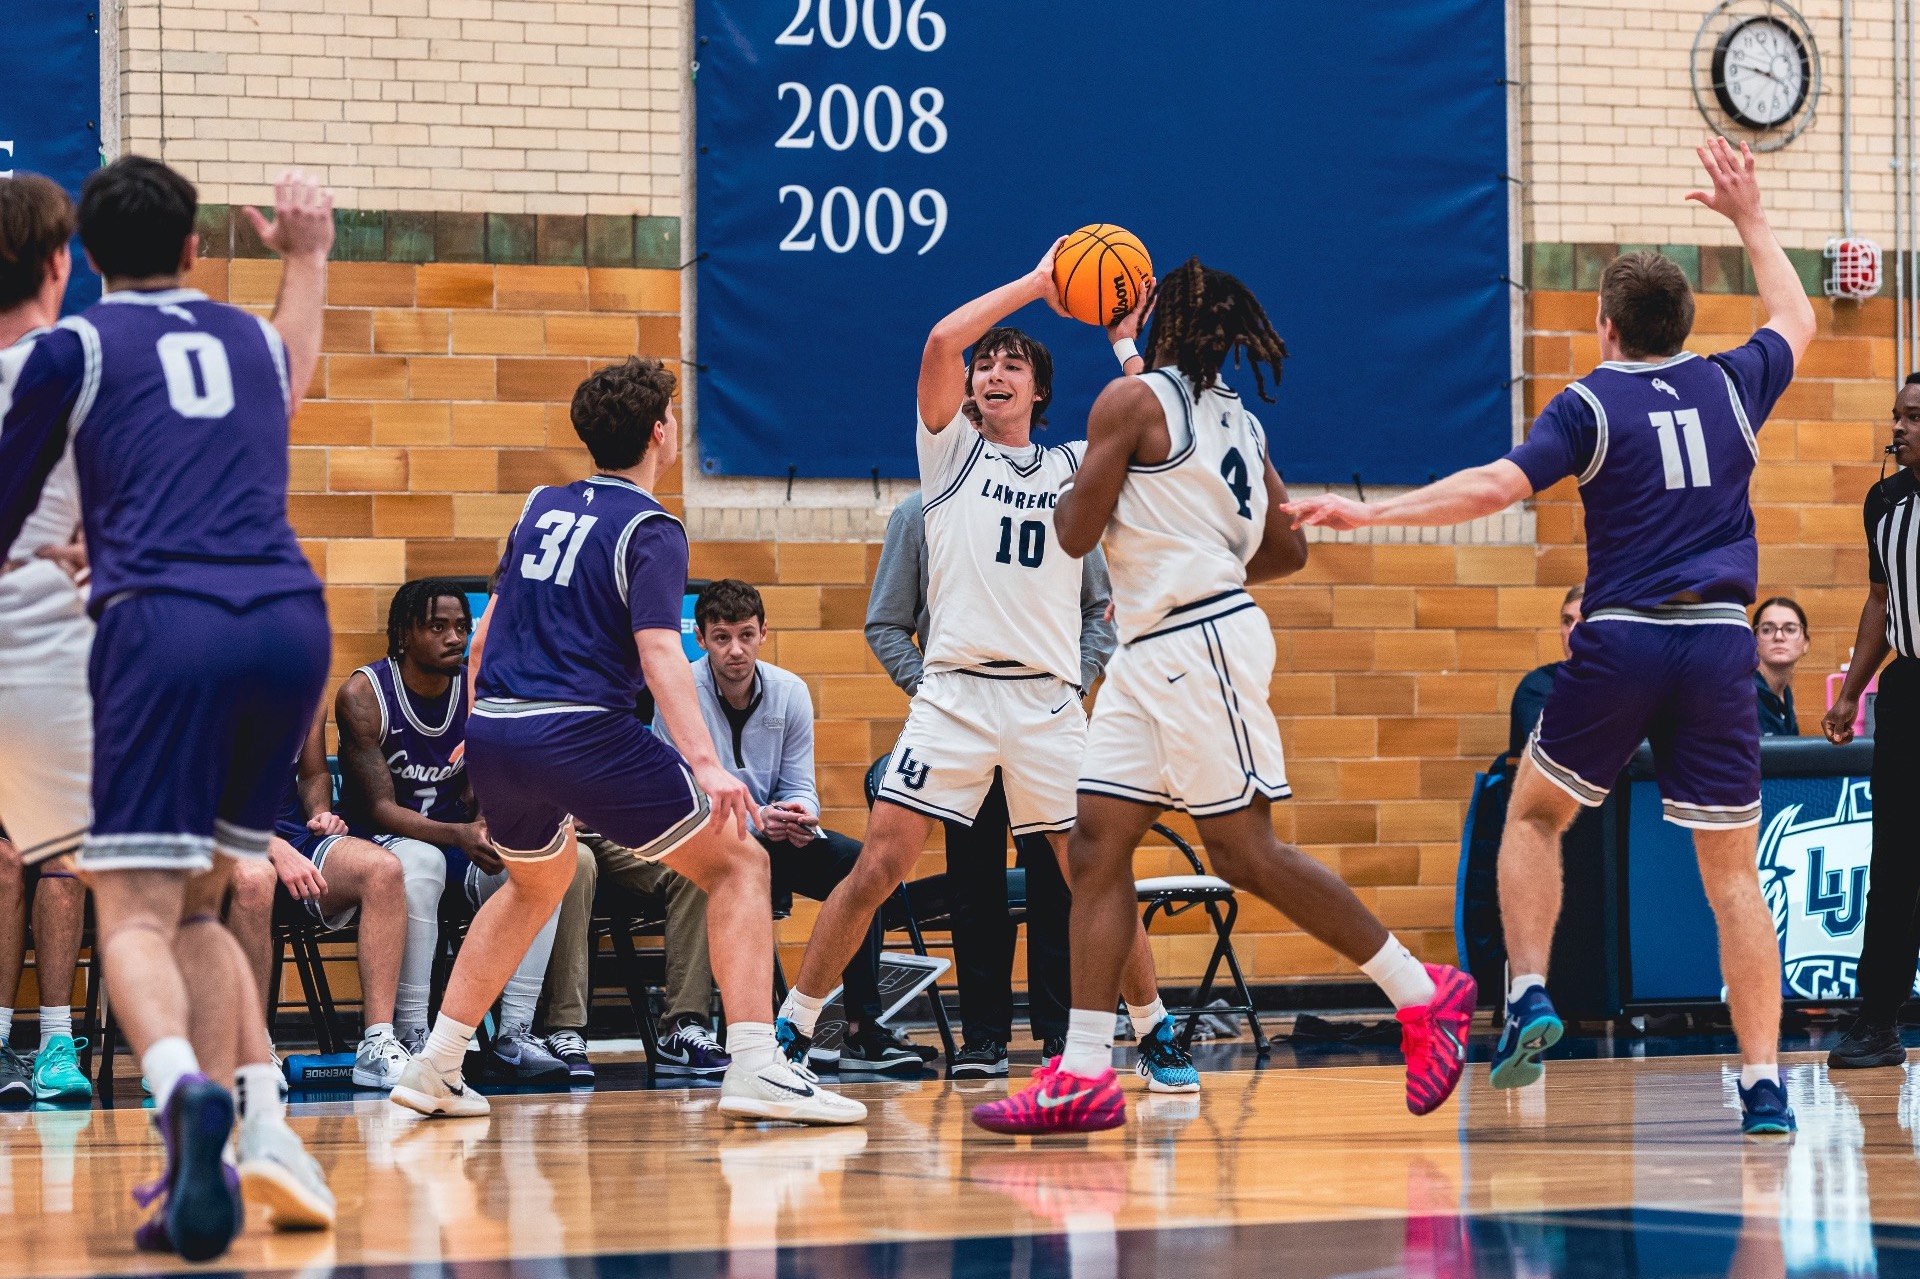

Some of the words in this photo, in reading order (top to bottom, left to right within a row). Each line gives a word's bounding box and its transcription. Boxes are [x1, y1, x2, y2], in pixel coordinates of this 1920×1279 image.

[774, 0, 947, 52] 2006
[774, 81, 948, 154] 2008
[778, 184, 948, 255] 2009
[156, 331, 235, 419] 0
[1220, 446, 1253, 521] 4
[1648, 408, 1711, 490] 11
[981, 478, 1058, 510] LAWRENC
[520, 509, 599, 587] 31
[995, 516, 1046, 569] 10
[413, 786, 438, 817] 7
[895, 746, 932, 791] LU
[1805, 846, 1868, 937] LU
[305, 1068, 355, 1080] OWERADE
